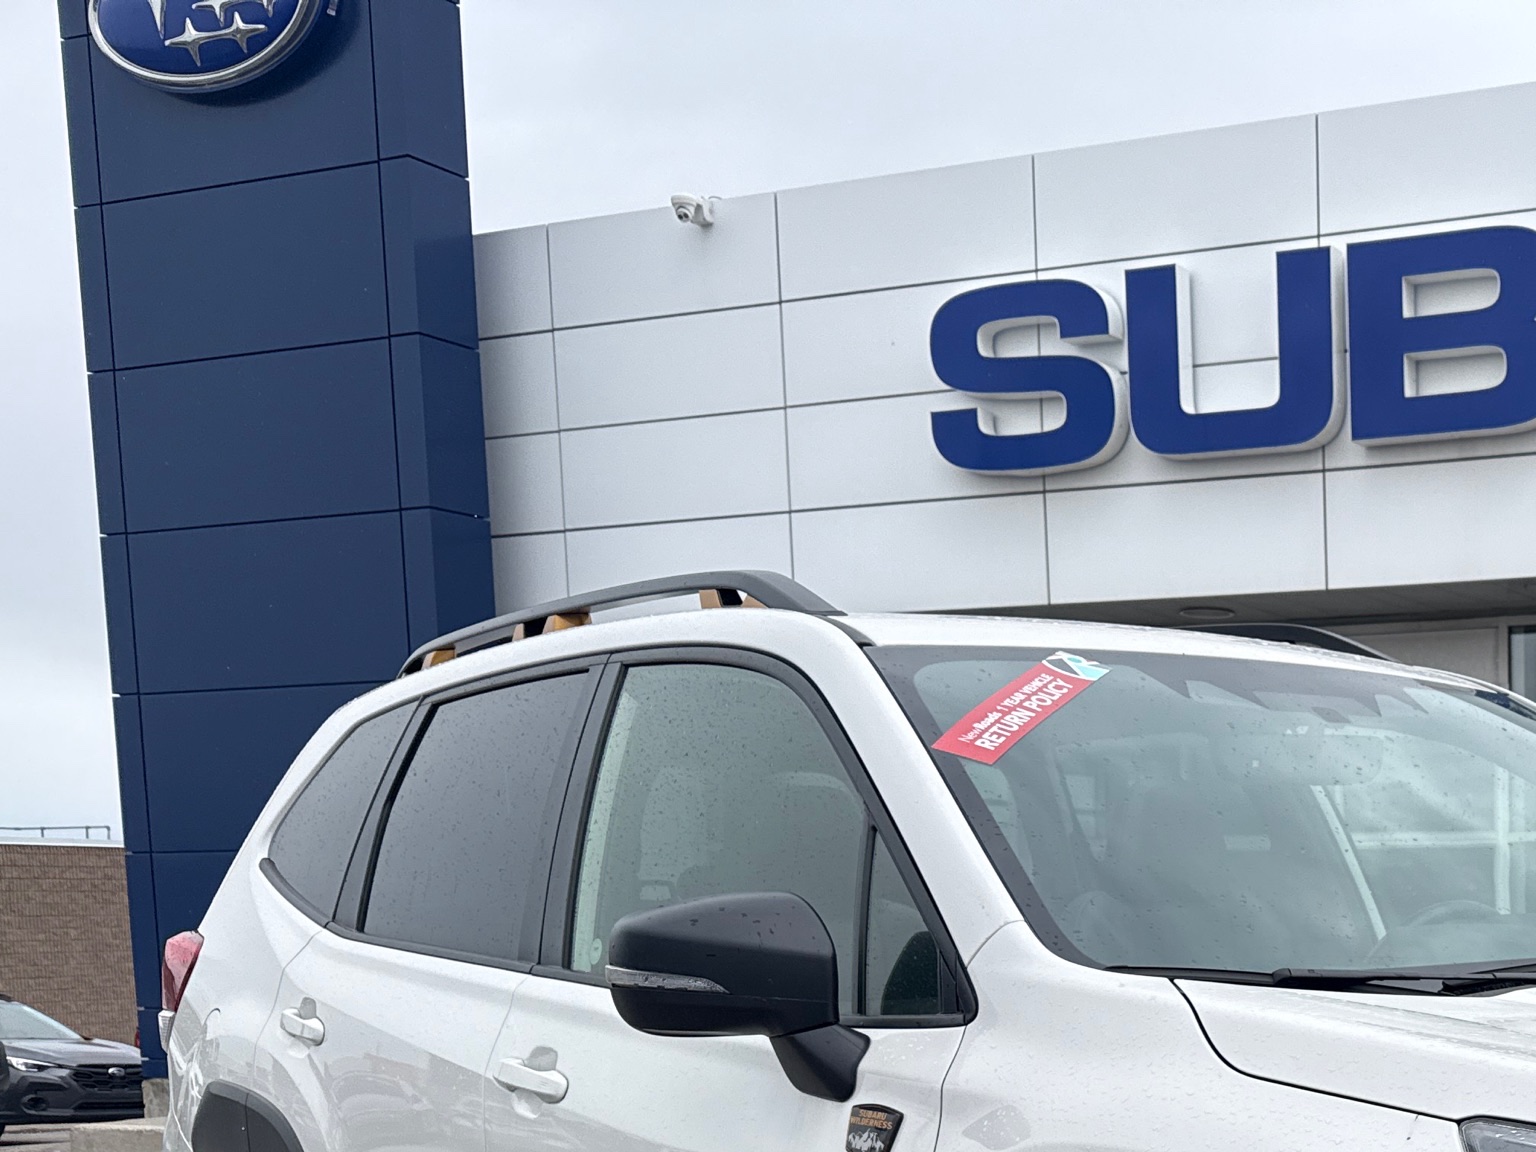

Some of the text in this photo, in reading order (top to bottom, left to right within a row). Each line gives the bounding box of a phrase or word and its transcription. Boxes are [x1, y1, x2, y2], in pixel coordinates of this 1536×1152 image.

[957, 710, 1003, 743] NewRoads
[1001, 692, 1027, 711] YEAR
[1019, 673, 1054, 698] VEHICLE
[974, 678, 1074, 750] RETURN POLICY
[850, 1116, 893, 1130] WILDERNESS
[859, 1109, 887, 1120] SUBARU
